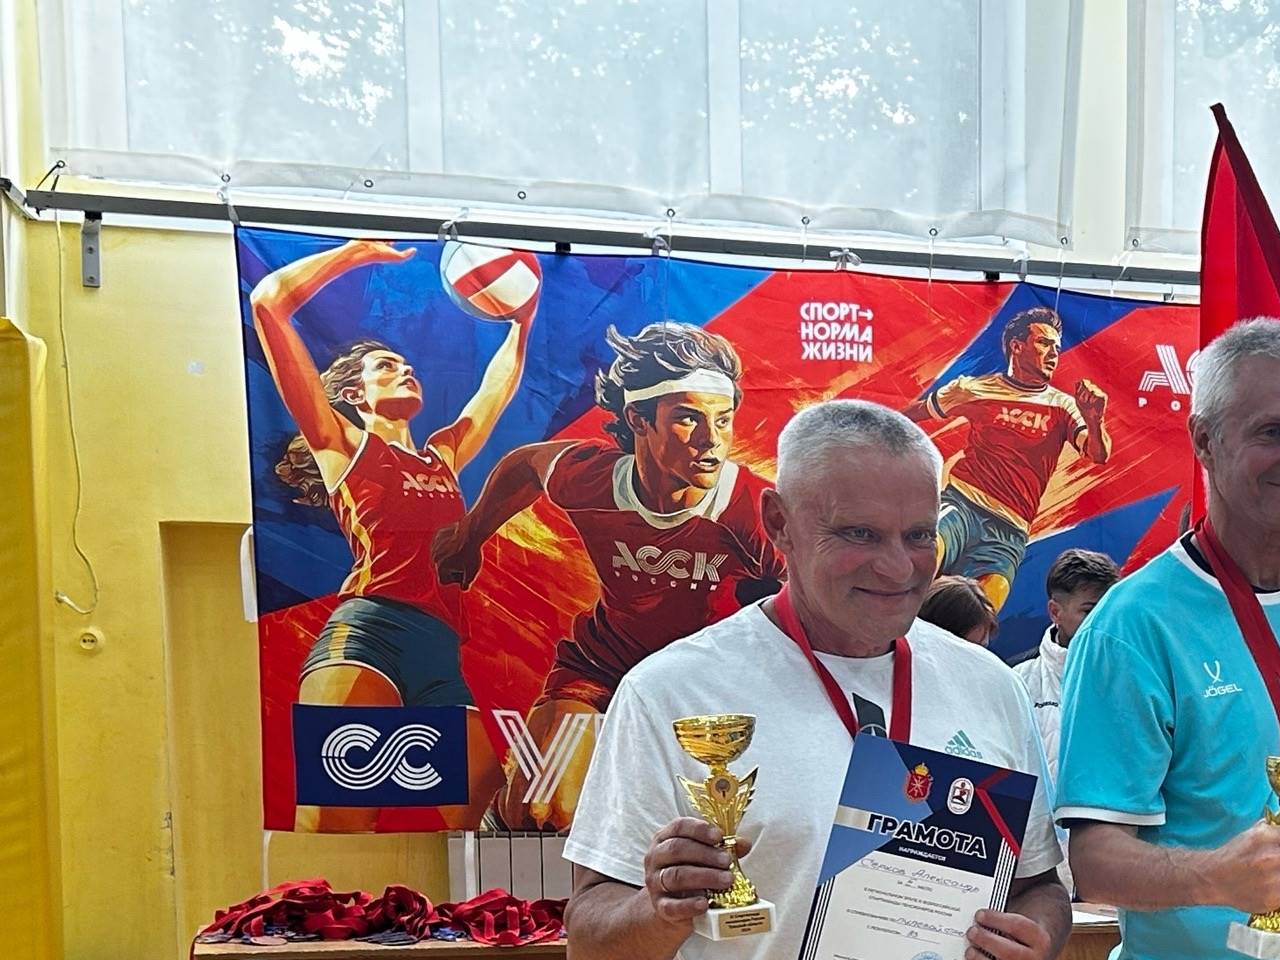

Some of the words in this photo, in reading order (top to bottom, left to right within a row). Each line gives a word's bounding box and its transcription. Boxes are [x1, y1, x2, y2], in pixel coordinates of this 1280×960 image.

[800, 302, 860, 322] СПОРТ
[800, 322, 873, 343] НОРМА
[801, 341, 873, 363] ЖИЗНИ
[1138, 344, 1200, 395] А
[1138, 396, 1182, 412] РО
[612, 540, 729, 582] АССК
[945, 746, 983, 759] adidas
[865, 812, 987, 859] ГРАМОТА
